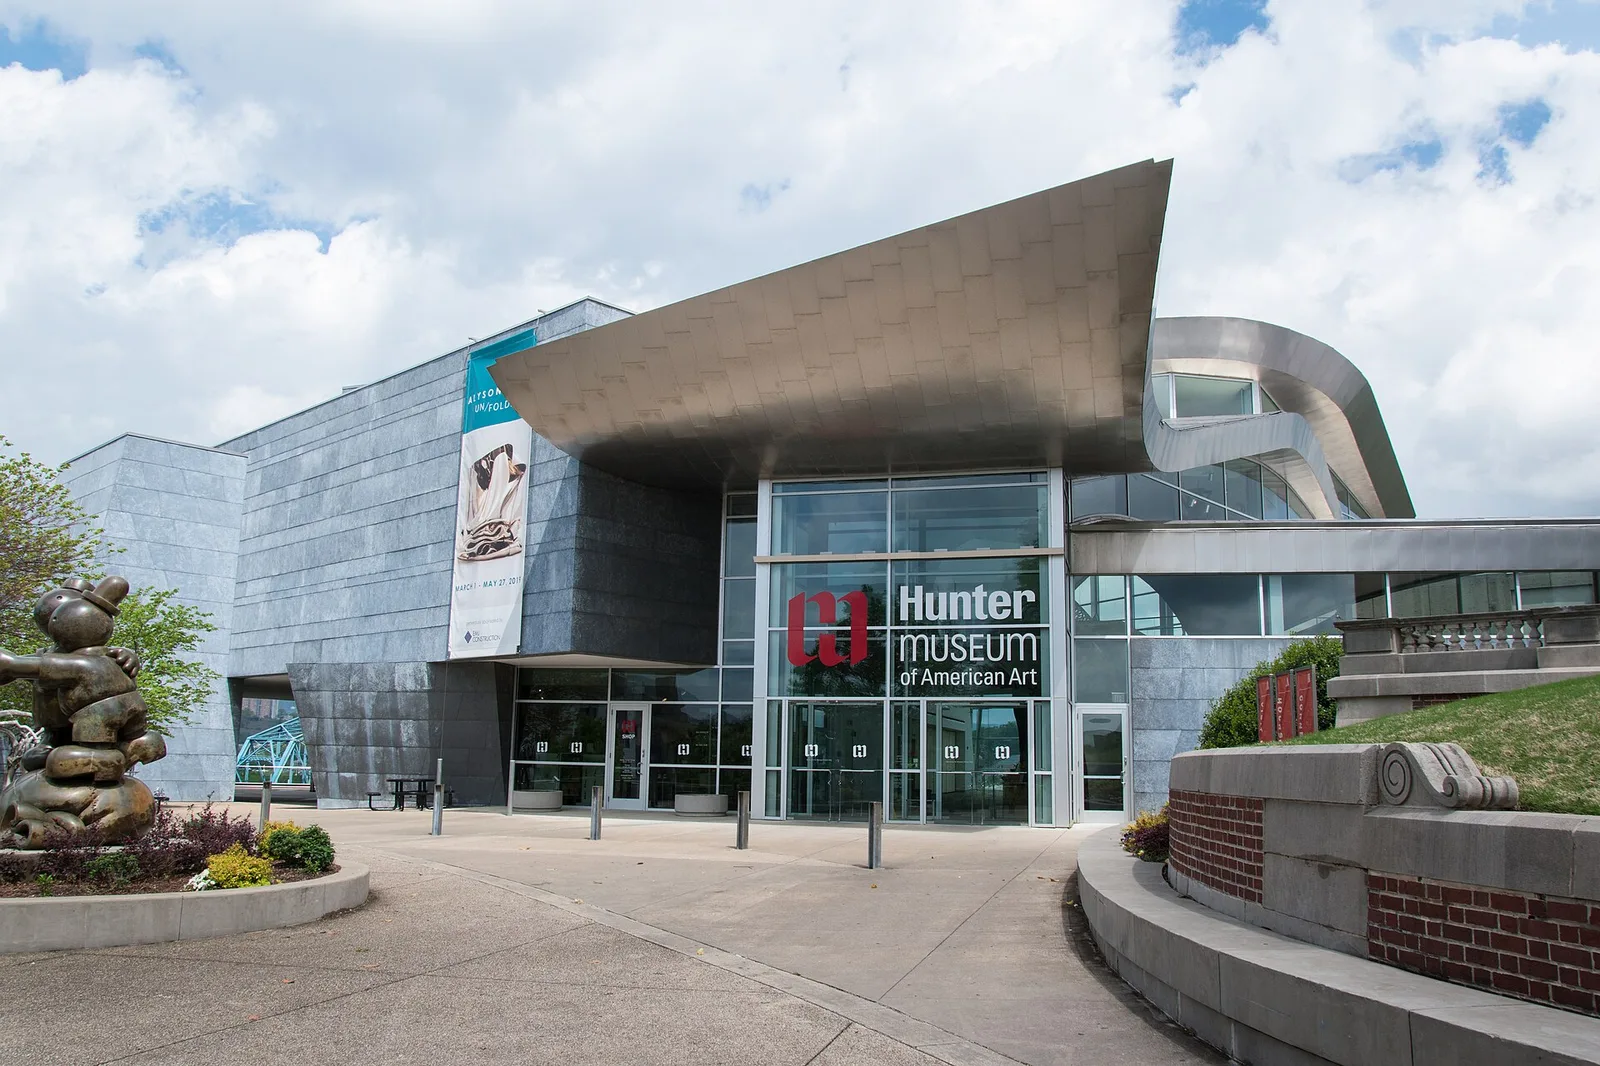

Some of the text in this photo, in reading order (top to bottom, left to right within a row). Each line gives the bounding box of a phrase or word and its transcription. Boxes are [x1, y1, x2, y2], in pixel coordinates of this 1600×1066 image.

[467, 387, 502, 405] ALYSON
[474, 400, 513, 413] UN/FOLD
[482, 580, 498, 588] MAY
[900, 584, 1036, 621] Hunter
[472, 634, 501, 643] CONSTRUCTION
[900, 667, 1037, 685] of American Art
